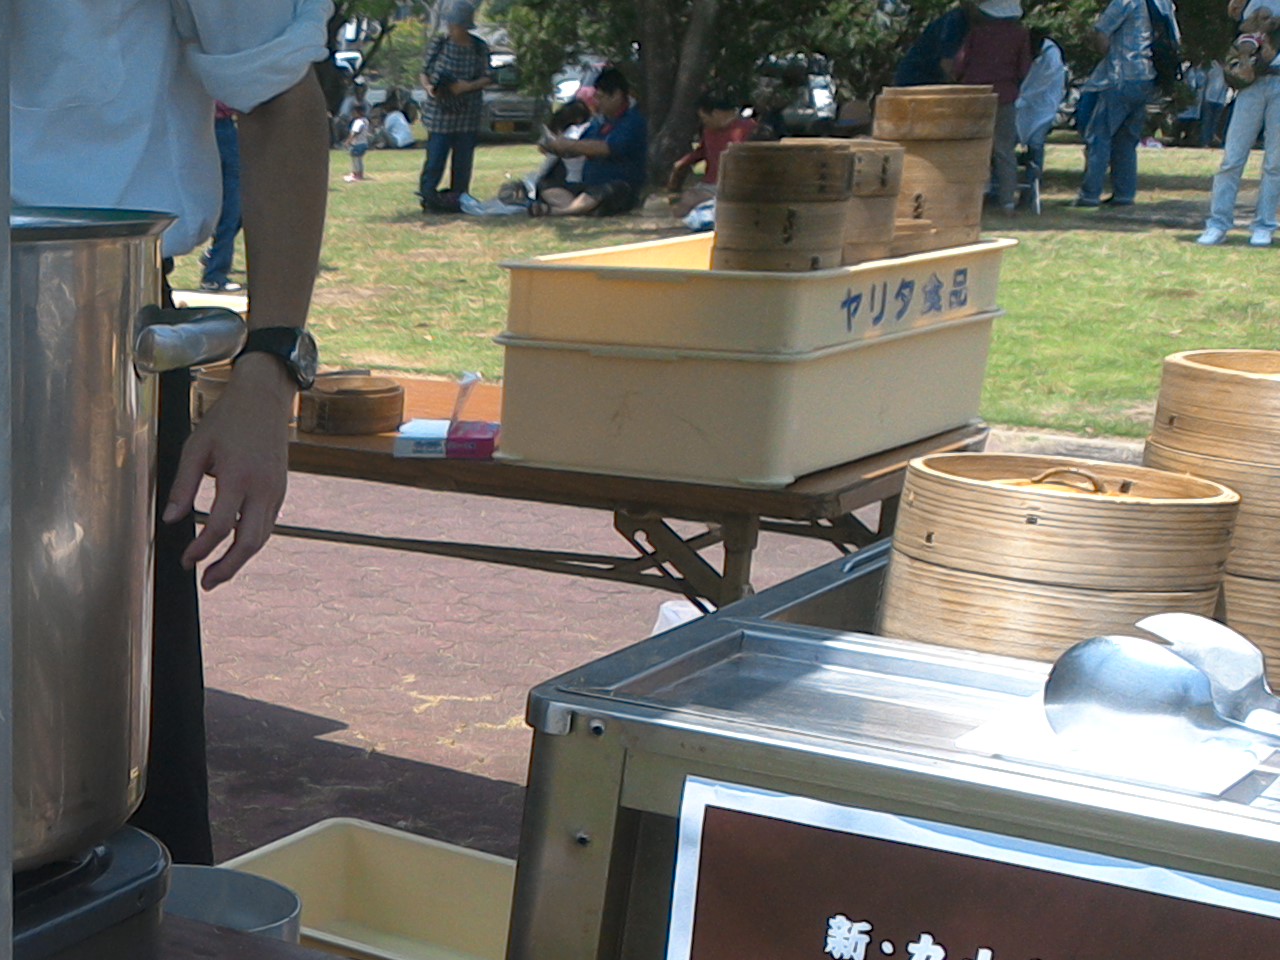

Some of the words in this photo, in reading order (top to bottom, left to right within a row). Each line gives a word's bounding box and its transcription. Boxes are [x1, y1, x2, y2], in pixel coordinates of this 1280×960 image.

[840, 267, 969, 333] ヤリタ食品
